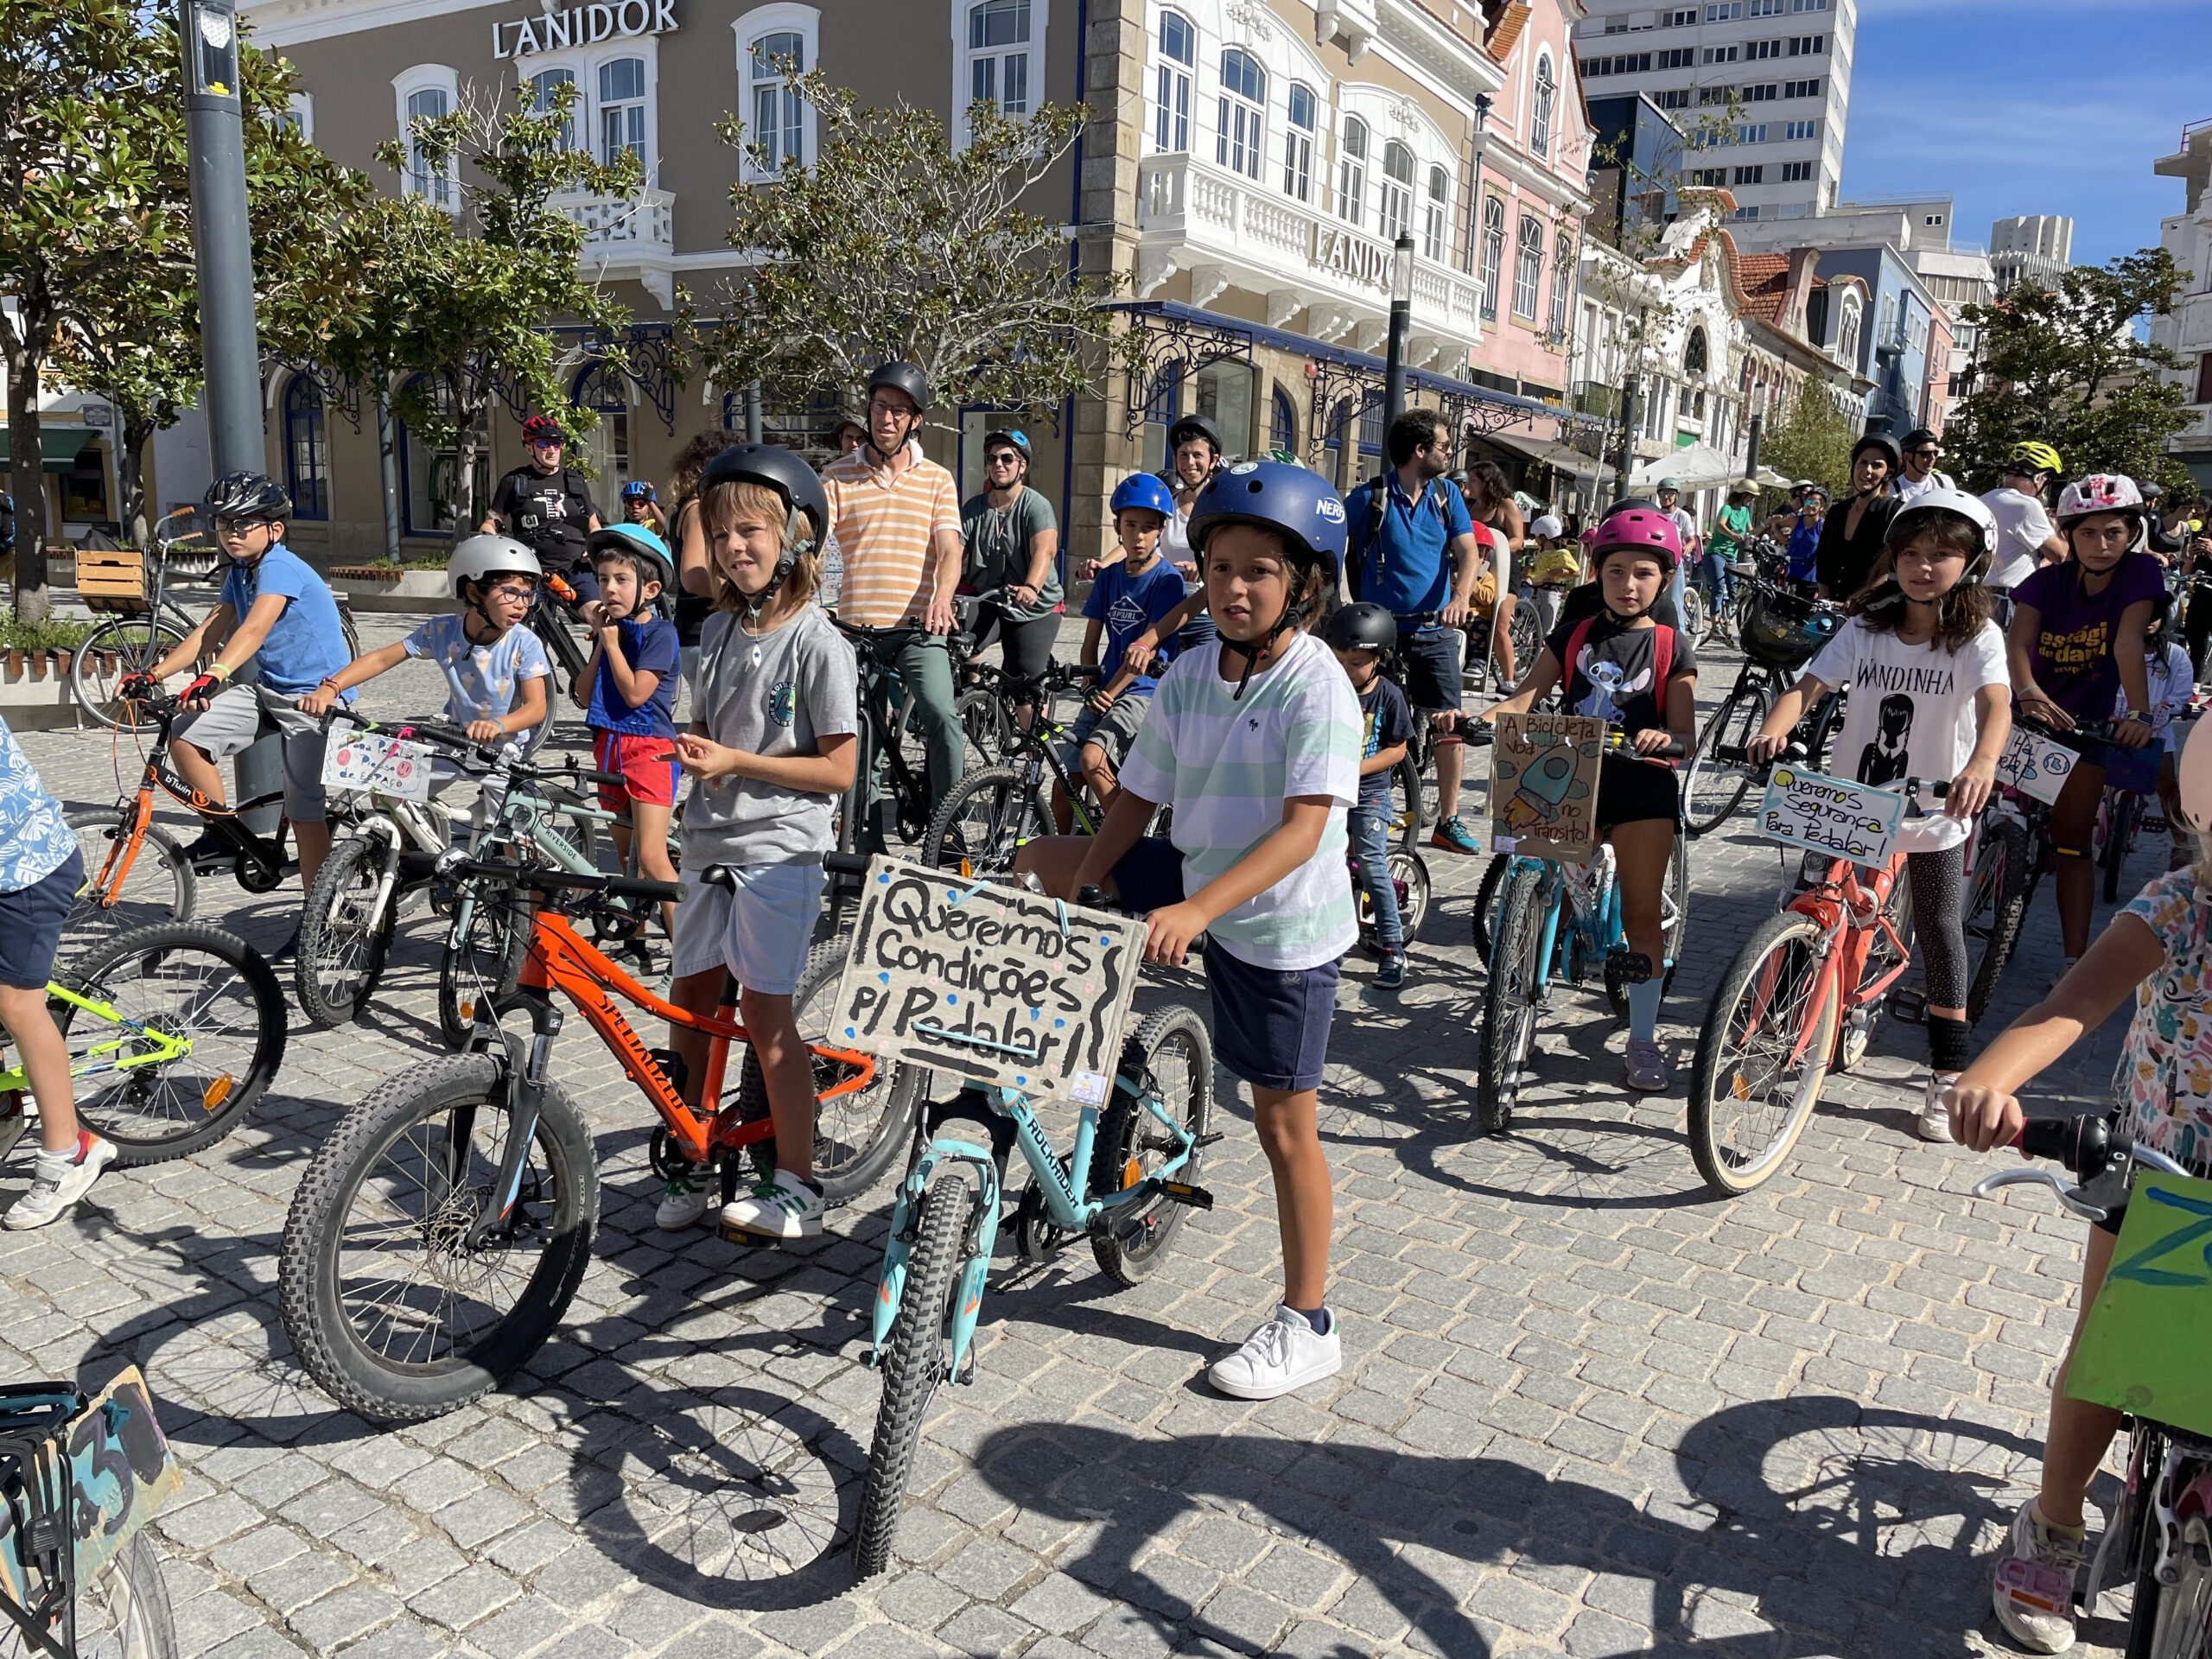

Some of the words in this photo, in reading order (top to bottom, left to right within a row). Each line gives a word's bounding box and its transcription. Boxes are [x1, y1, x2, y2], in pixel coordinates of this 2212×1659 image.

[493, 0, 679, 59] LANIDOR
[1312, 222, 1394, 291] LANID
[1316, 499, 1344, 518] NERF
[1857, 658, 1954, 695] WANDINHA
[1505, 716, 1517, 734] A
[1527, 718, 1596, 741] Bicicleta
[1774, 770, 1862, 810] Queremos
[1562, 804, 1581, 817] no
[1766, 811, 1794, 836] Para
[1784, 794, 1884, 834] Segurança
[545, 829, 577, 861] RIVERSIDE
[883, 879, 1091, 975] Queremos
[876, 929, 1082, 1012] Condições
[594, 994, 684, 1109] SPECIALIZED
[1027, 1118, 1079, 1209] ROCKRIDER
